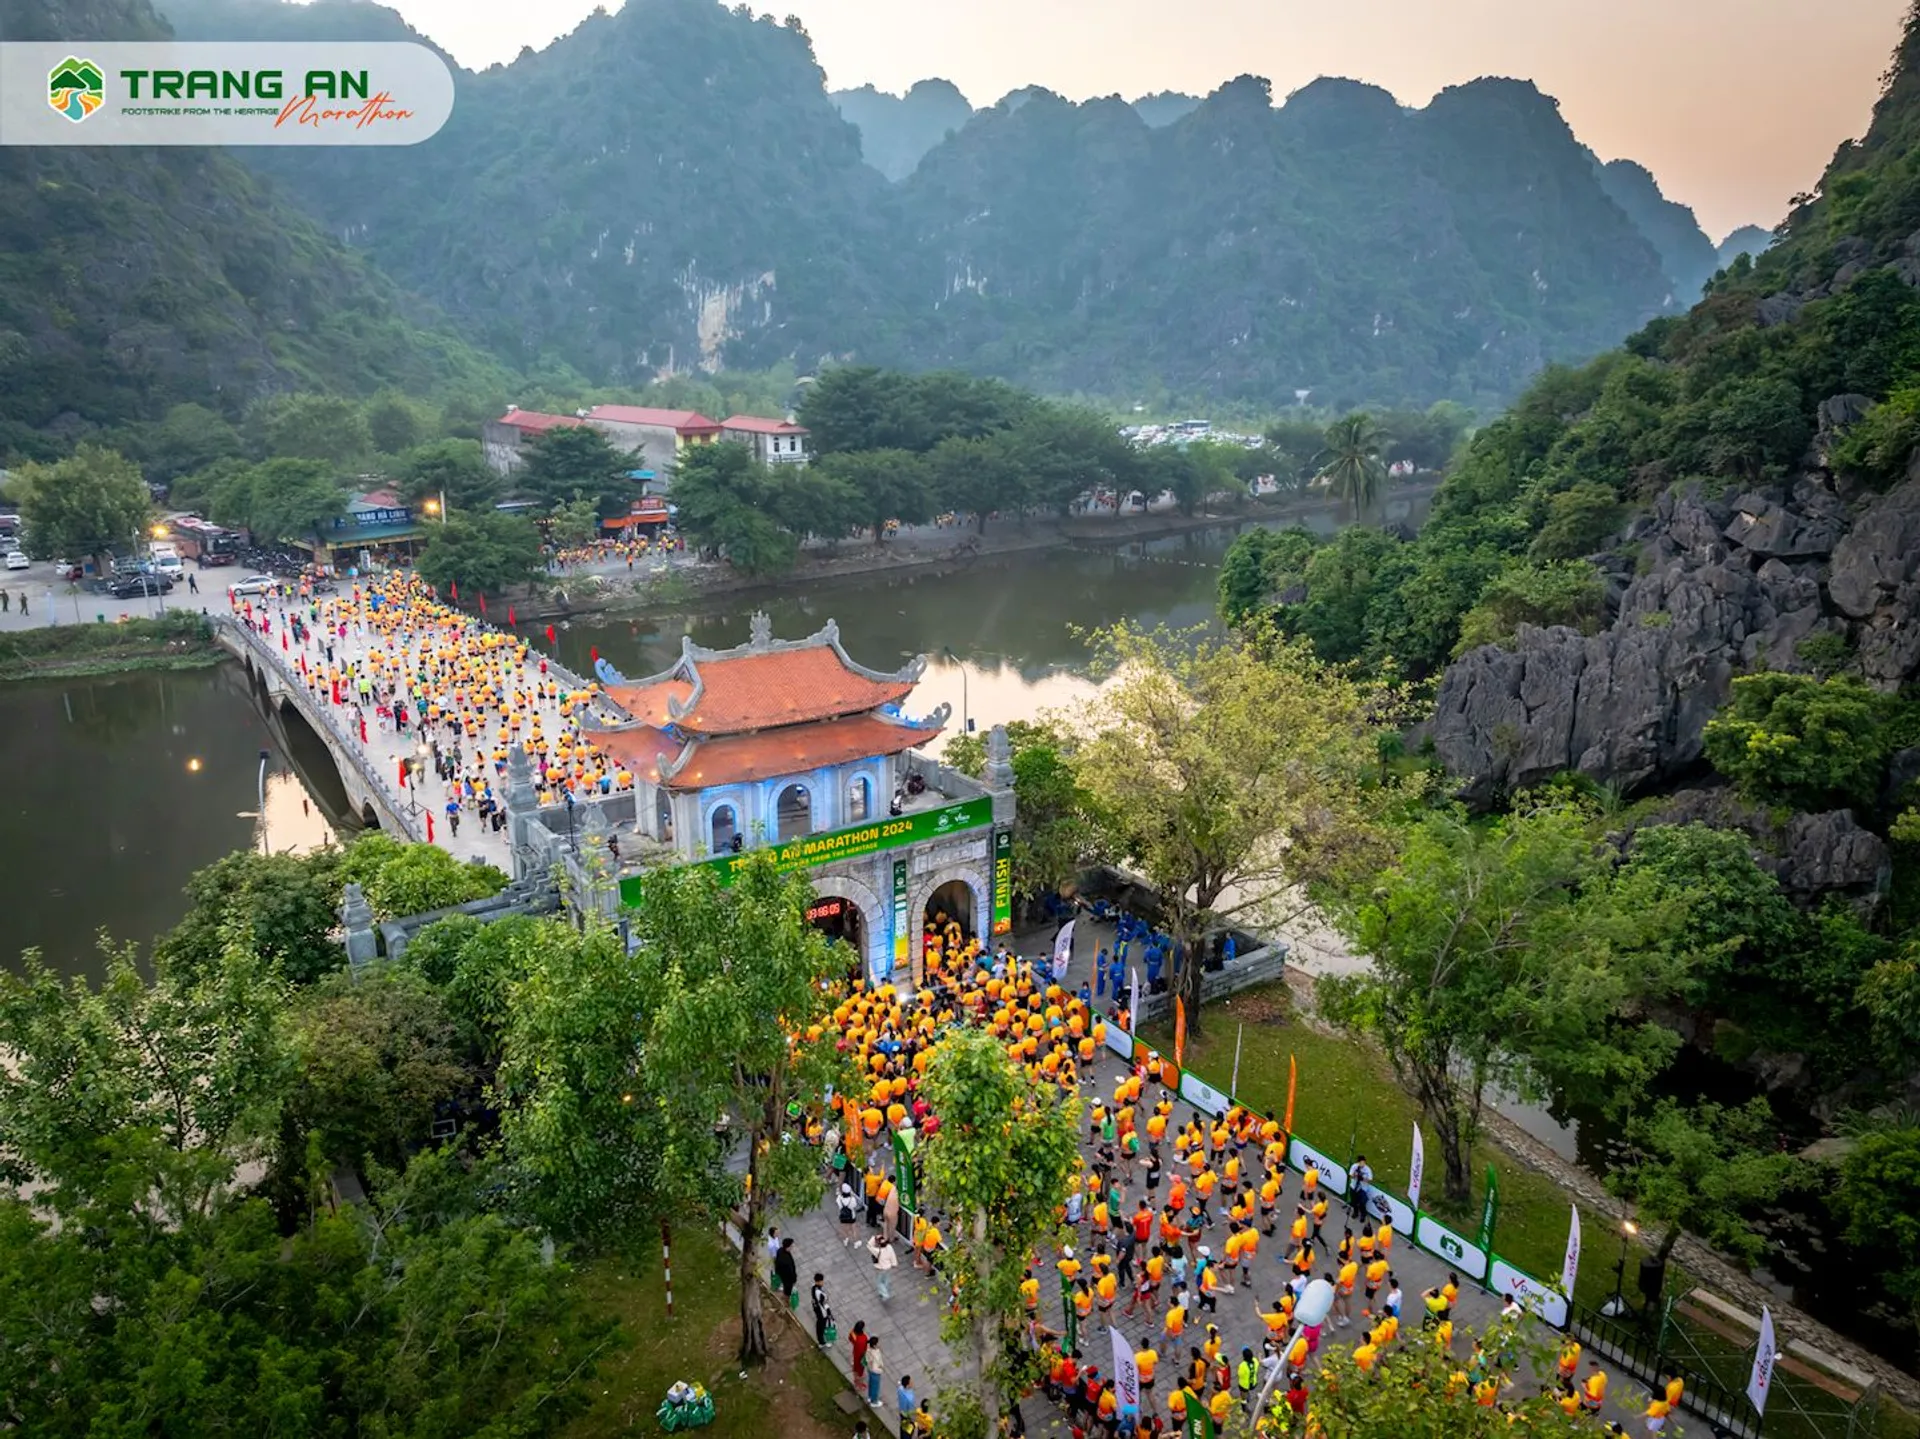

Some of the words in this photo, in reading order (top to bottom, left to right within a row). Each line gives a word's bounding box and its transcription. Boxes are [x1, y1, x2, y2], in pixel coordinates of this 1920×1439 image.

[804, 828, 879, 856] MARATHON
[882, 820, 913, 838] 2024
[996, 858, 1008, 908] FINISH
